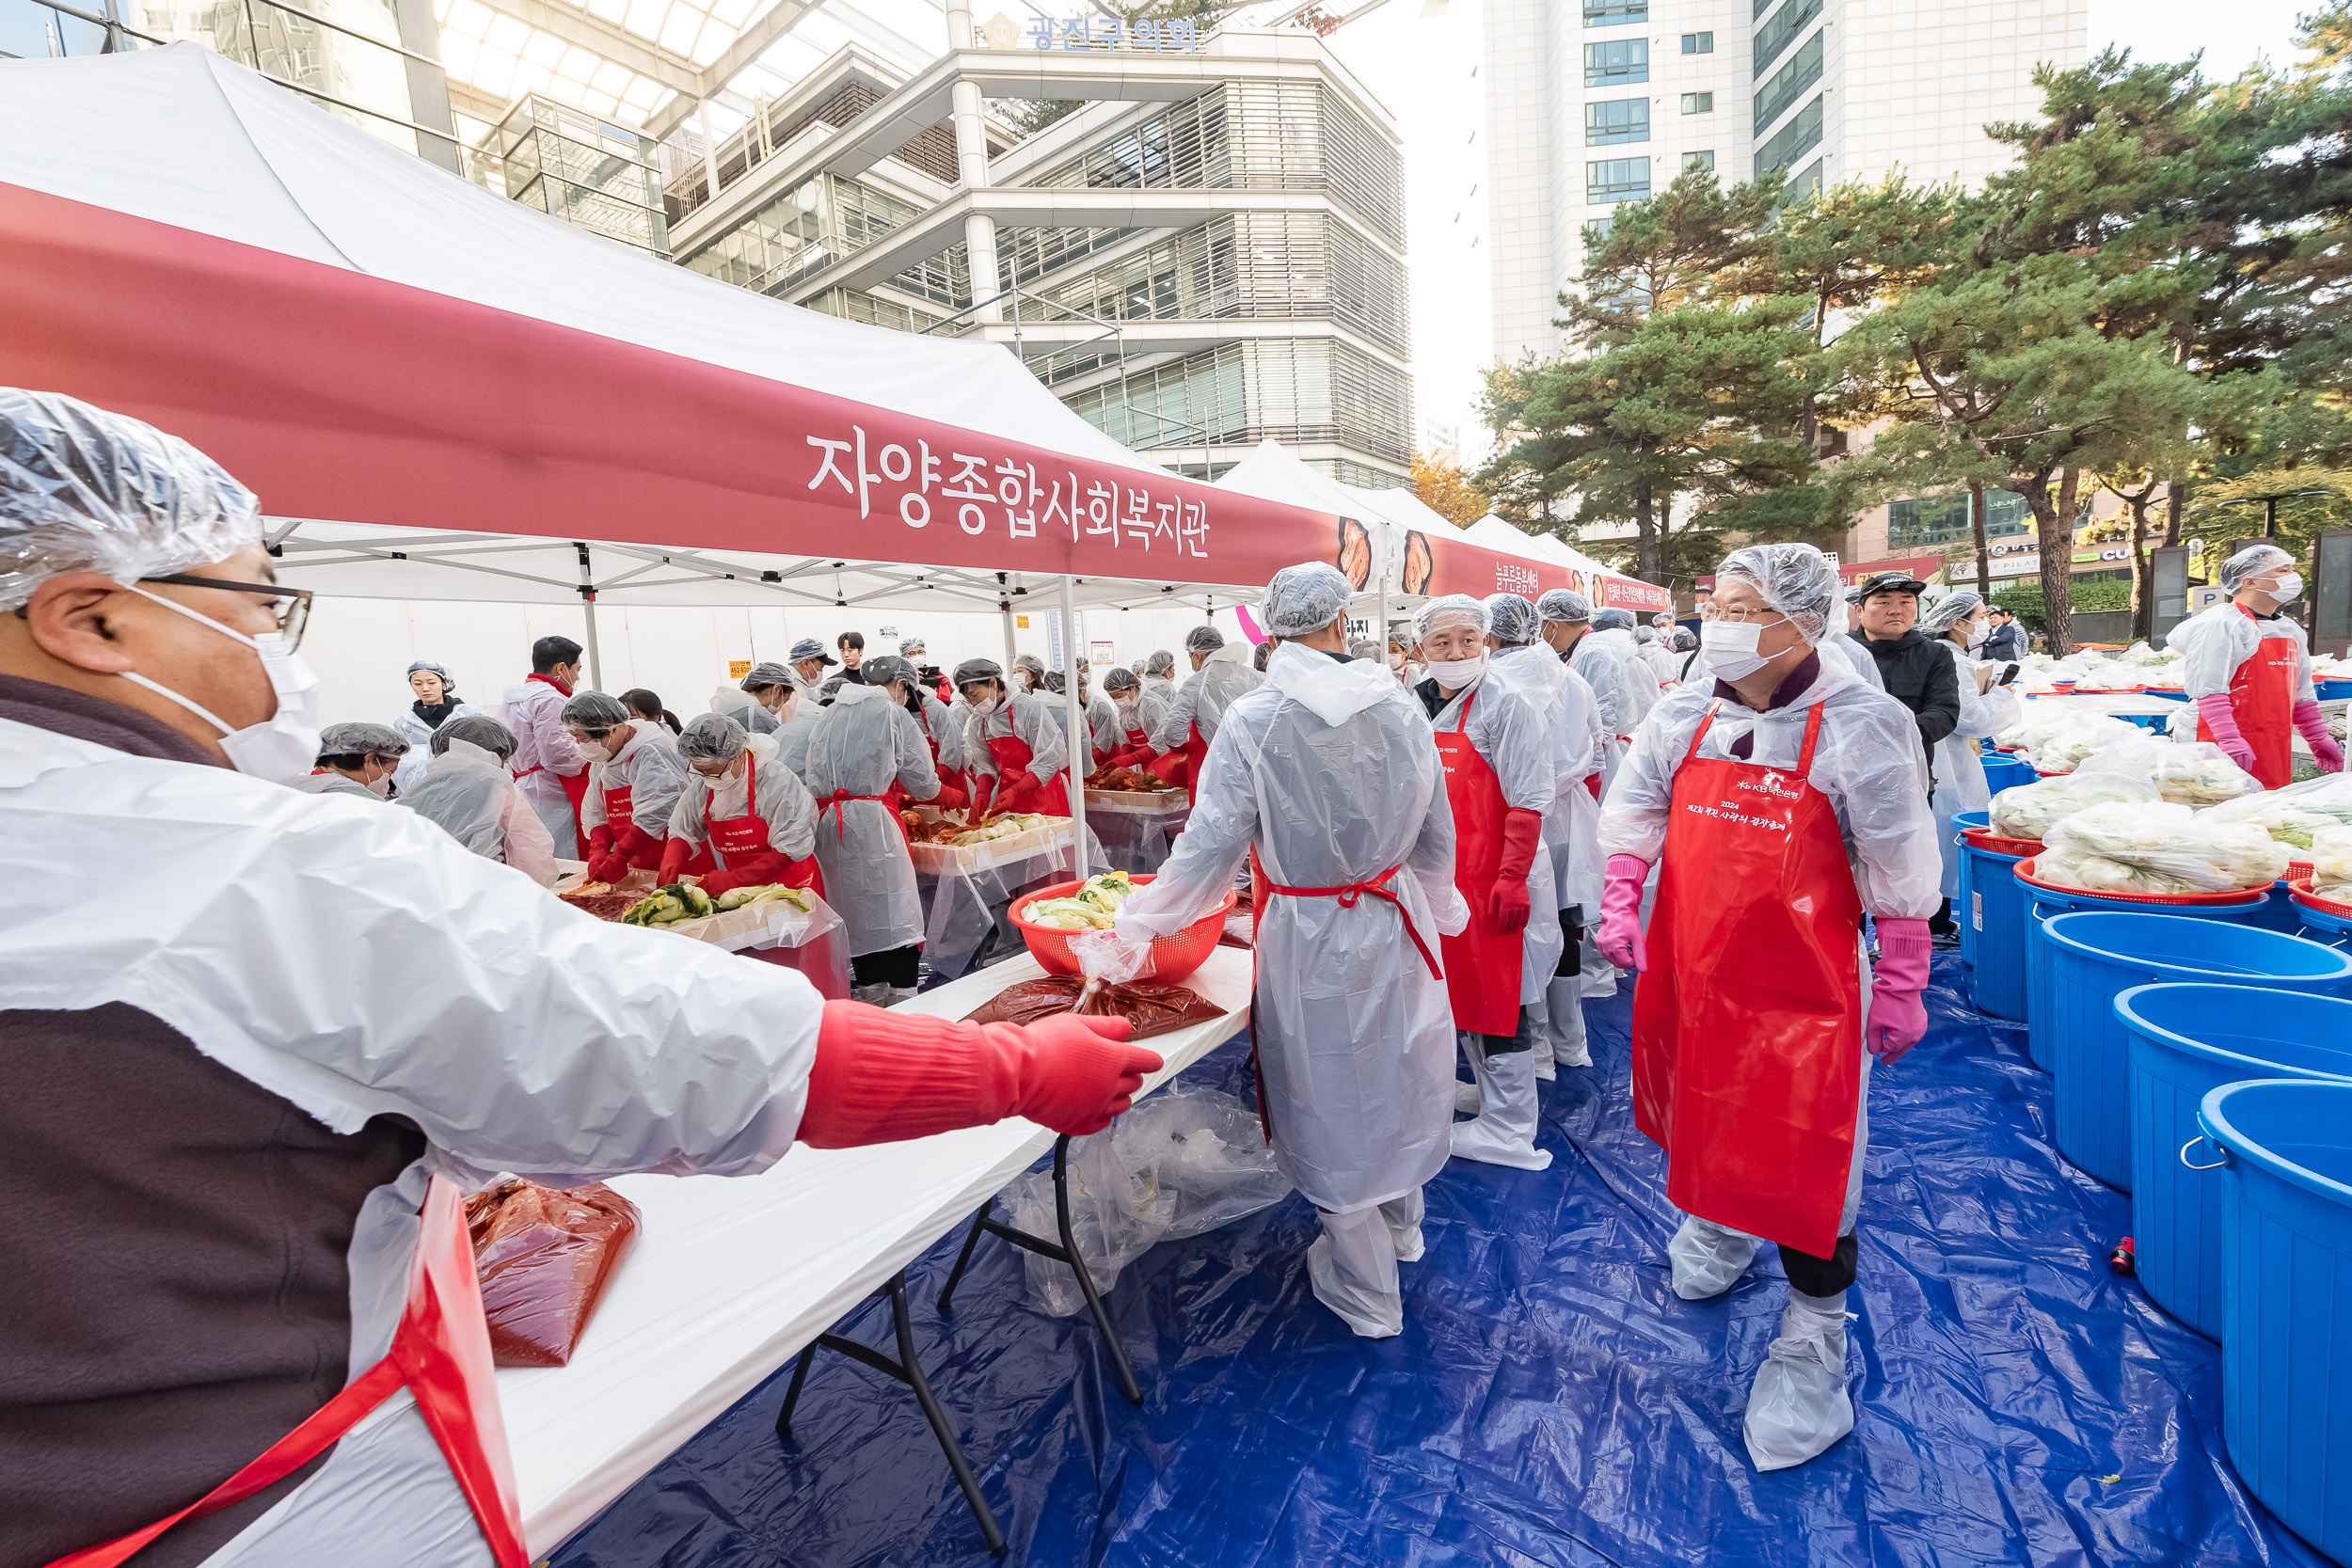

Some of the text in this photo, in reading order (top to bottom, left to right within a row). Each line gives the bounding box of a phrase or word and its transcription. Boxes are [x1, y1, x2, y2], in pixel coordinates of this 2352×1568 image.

[1026, 17, 1197, 55] 광진구의회
[806, 424, 1211, 558] 자양종합사회복지관
[2102, 548, 2130, 561] CU
[2003, 560, 2038, 569] PILAT
[1495, 561, 1539, 595] 늘푸른돌봄센터
[2203, 594, 2217, 605] P
[1752, 784, 1800, 800] KB 국민은행
[1720, 800, 1740, 810] 2024
[1686, 804, 1704, 815] 제2회
[1705, 806, 1719, 818] 광진
[1720, 811, 1749, 824] 사랑의
